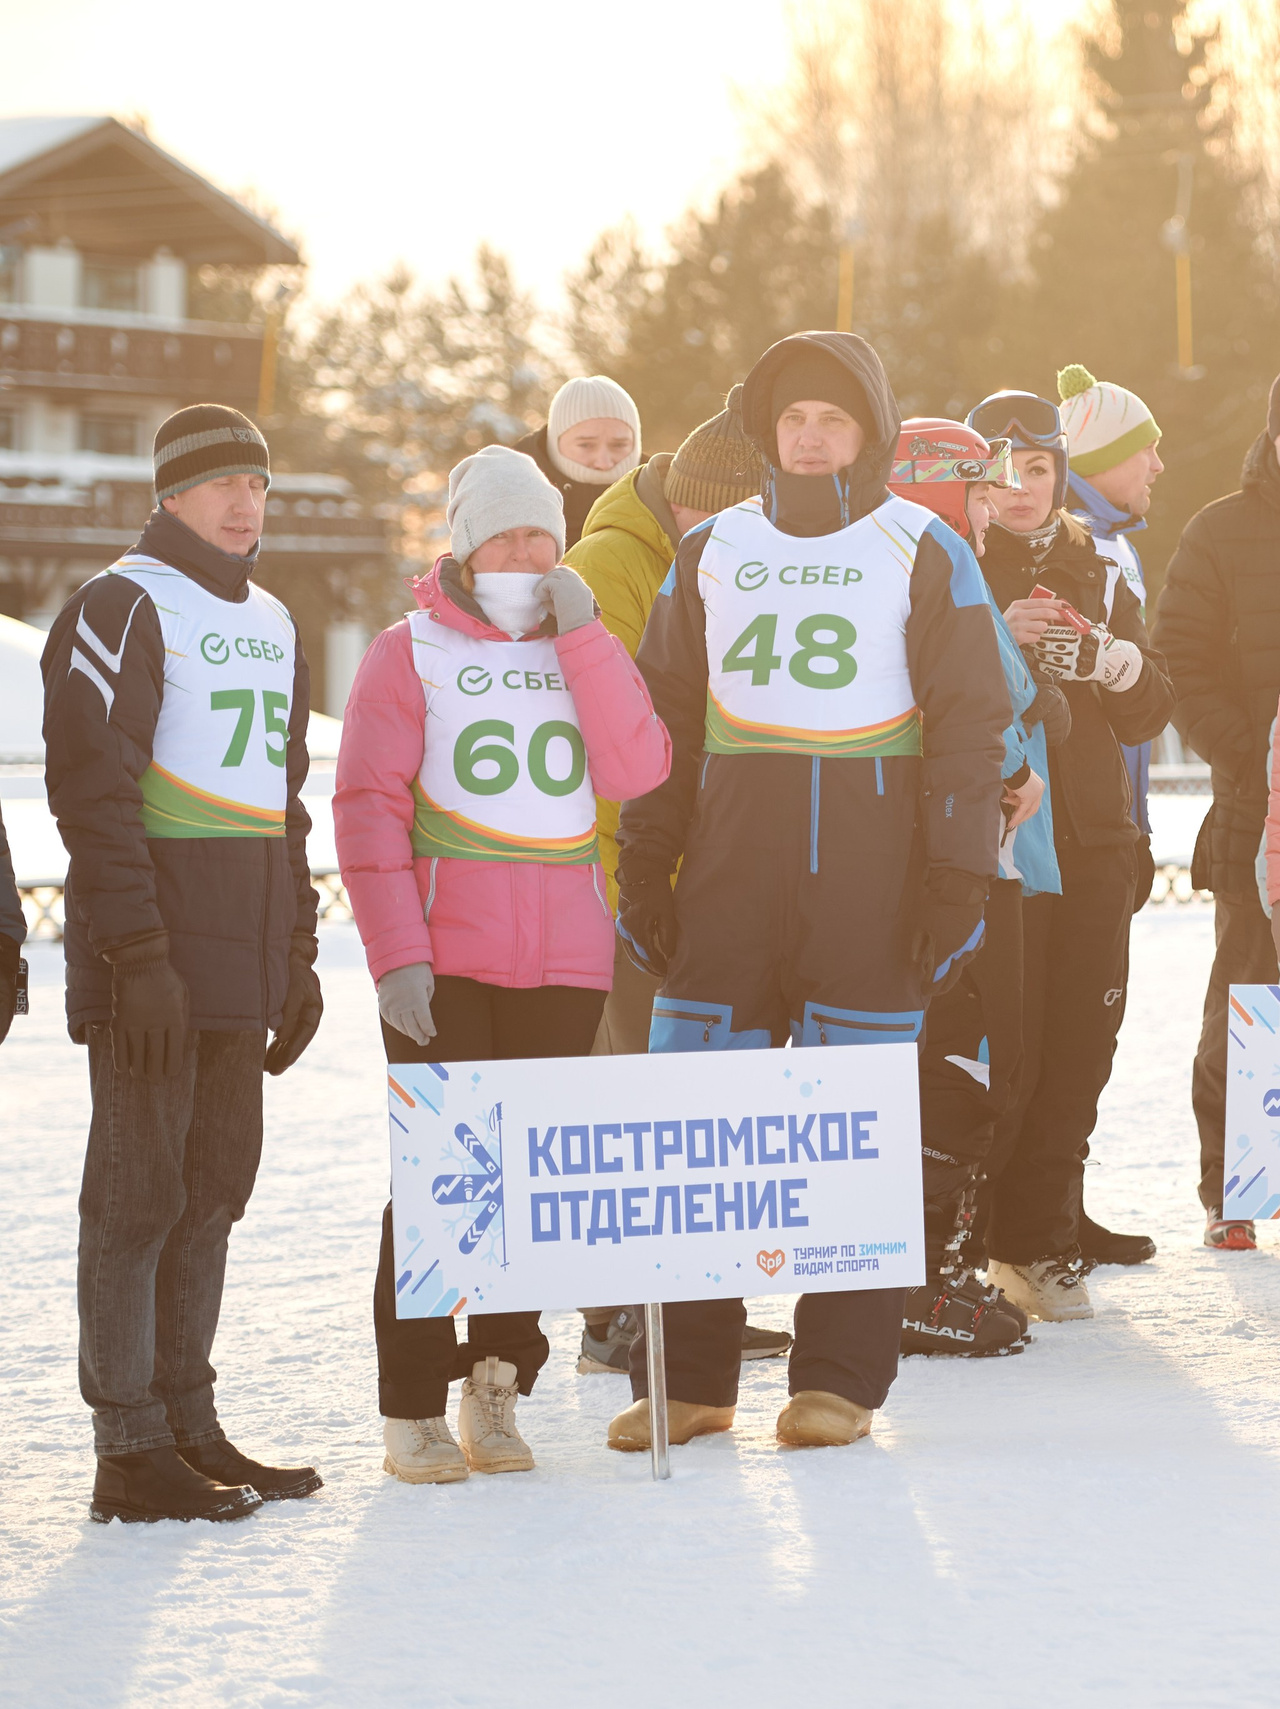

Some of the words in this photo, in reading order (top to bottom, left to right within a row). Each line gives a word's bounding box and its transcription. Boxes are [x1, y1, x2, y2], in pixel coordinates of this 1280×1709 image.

[778, 565, 864, 587] СБЕР
[234, 637, 285, 664] СБЕР
[721, 613, 858, 690] 48
[210, 688, 290, 768] 75
[453, 718, 586, 797] 60
[527, 1110, 879, 1177] КОСТРОМСКОЕ
[530, 1178, 809, 1246] ОТДЕЛЕНИЕ
[793, 1245, 838, 1260] ТУРНИР
[841, 1244, 856, 1257] ПО
[858, 1241, 907, 1257] ЗИМНИМ
[793, 1261, 833, 1276] ВИДАМ
[836, 1258, 880, 1273] СПОРТА
[902, 1318, 975, 1342] HEAD
